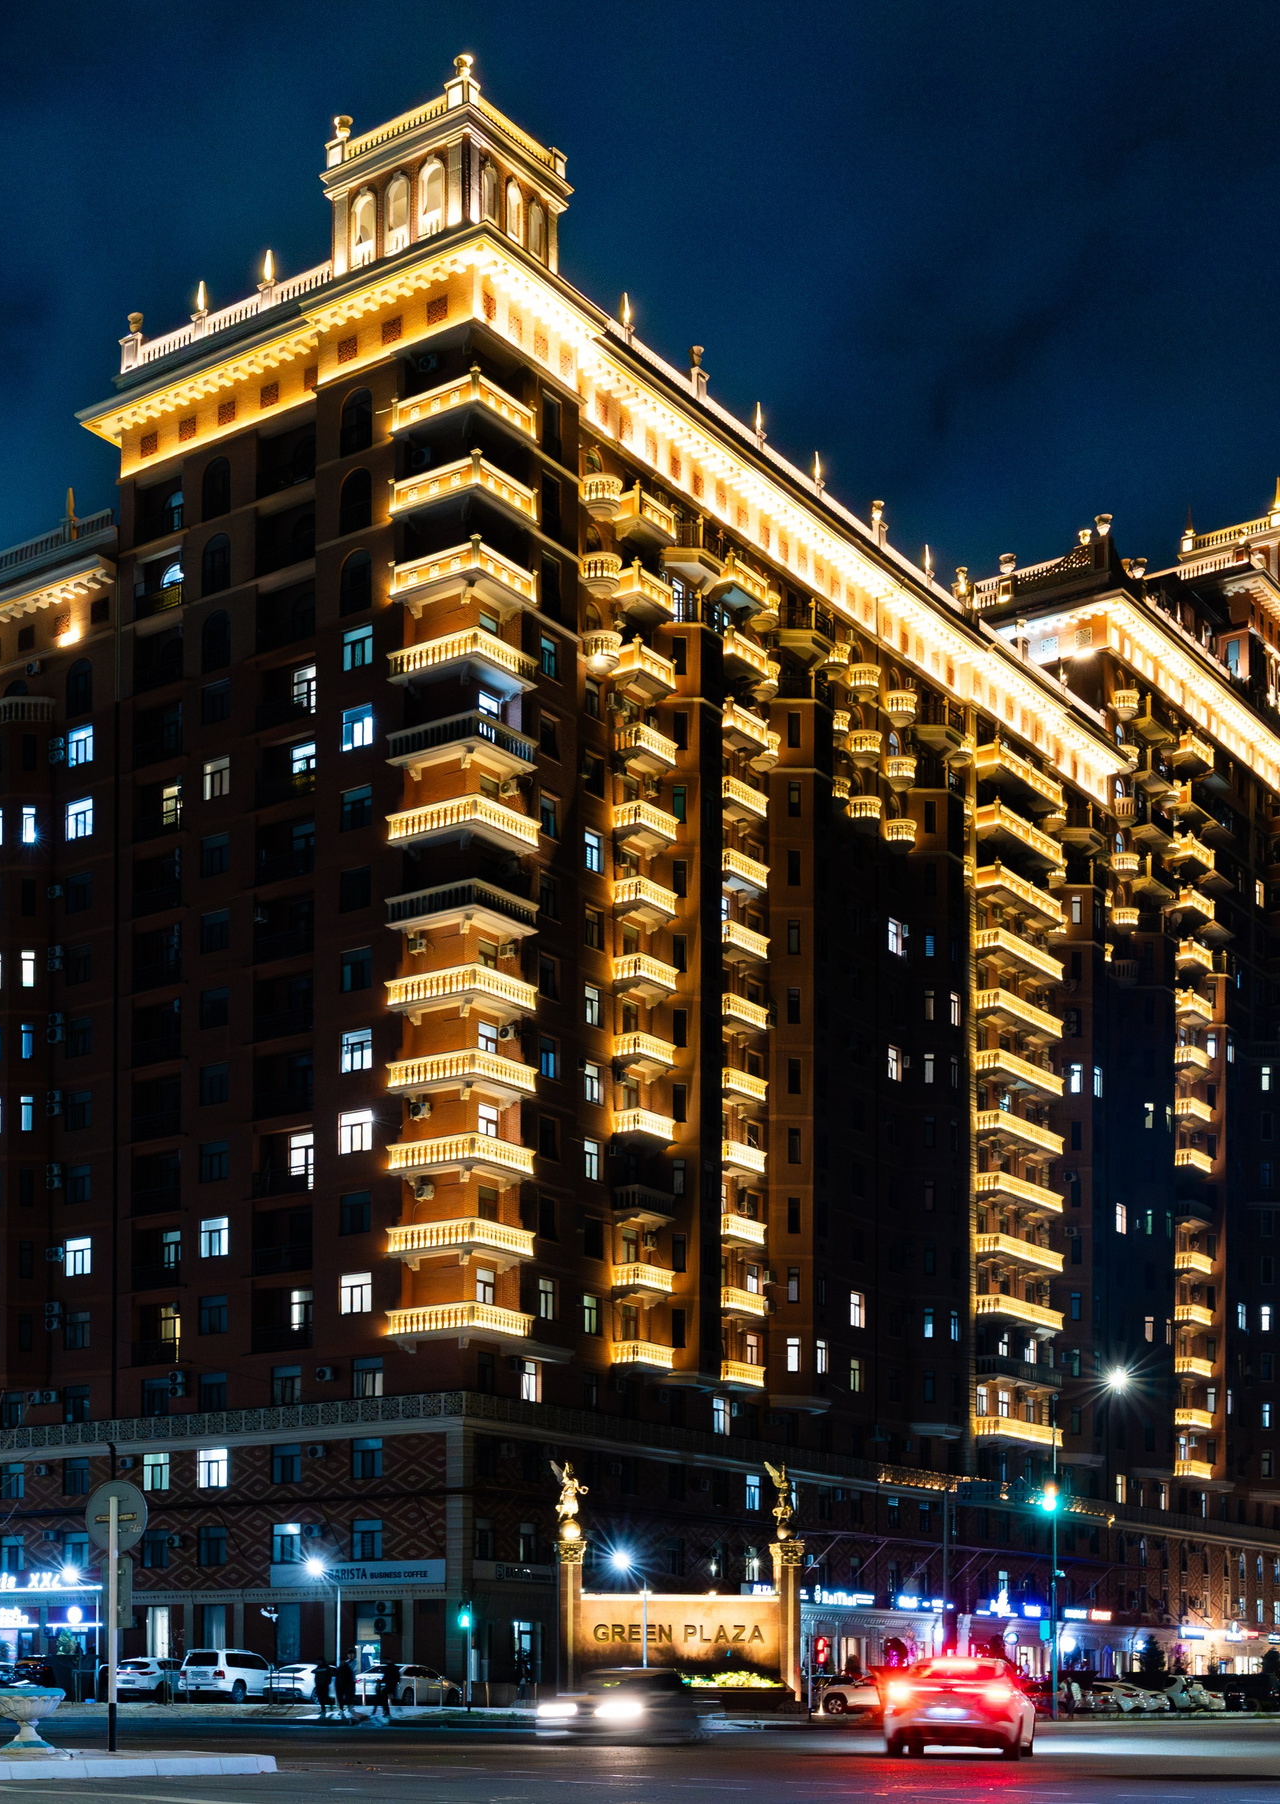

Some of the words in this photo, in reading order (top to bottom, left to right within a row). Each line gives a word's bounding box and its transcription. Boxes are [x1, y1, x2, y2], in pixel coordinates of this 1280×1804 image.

[27, 1571, 62, 1588] XXL
[370, 1571, 402, 1579] BUSINESS
[403, 1570, 429, 1578] COFFEE
[593, 1624, 673, 1644] GREEN
[683, 1624, 765, 1644] PLAZA
